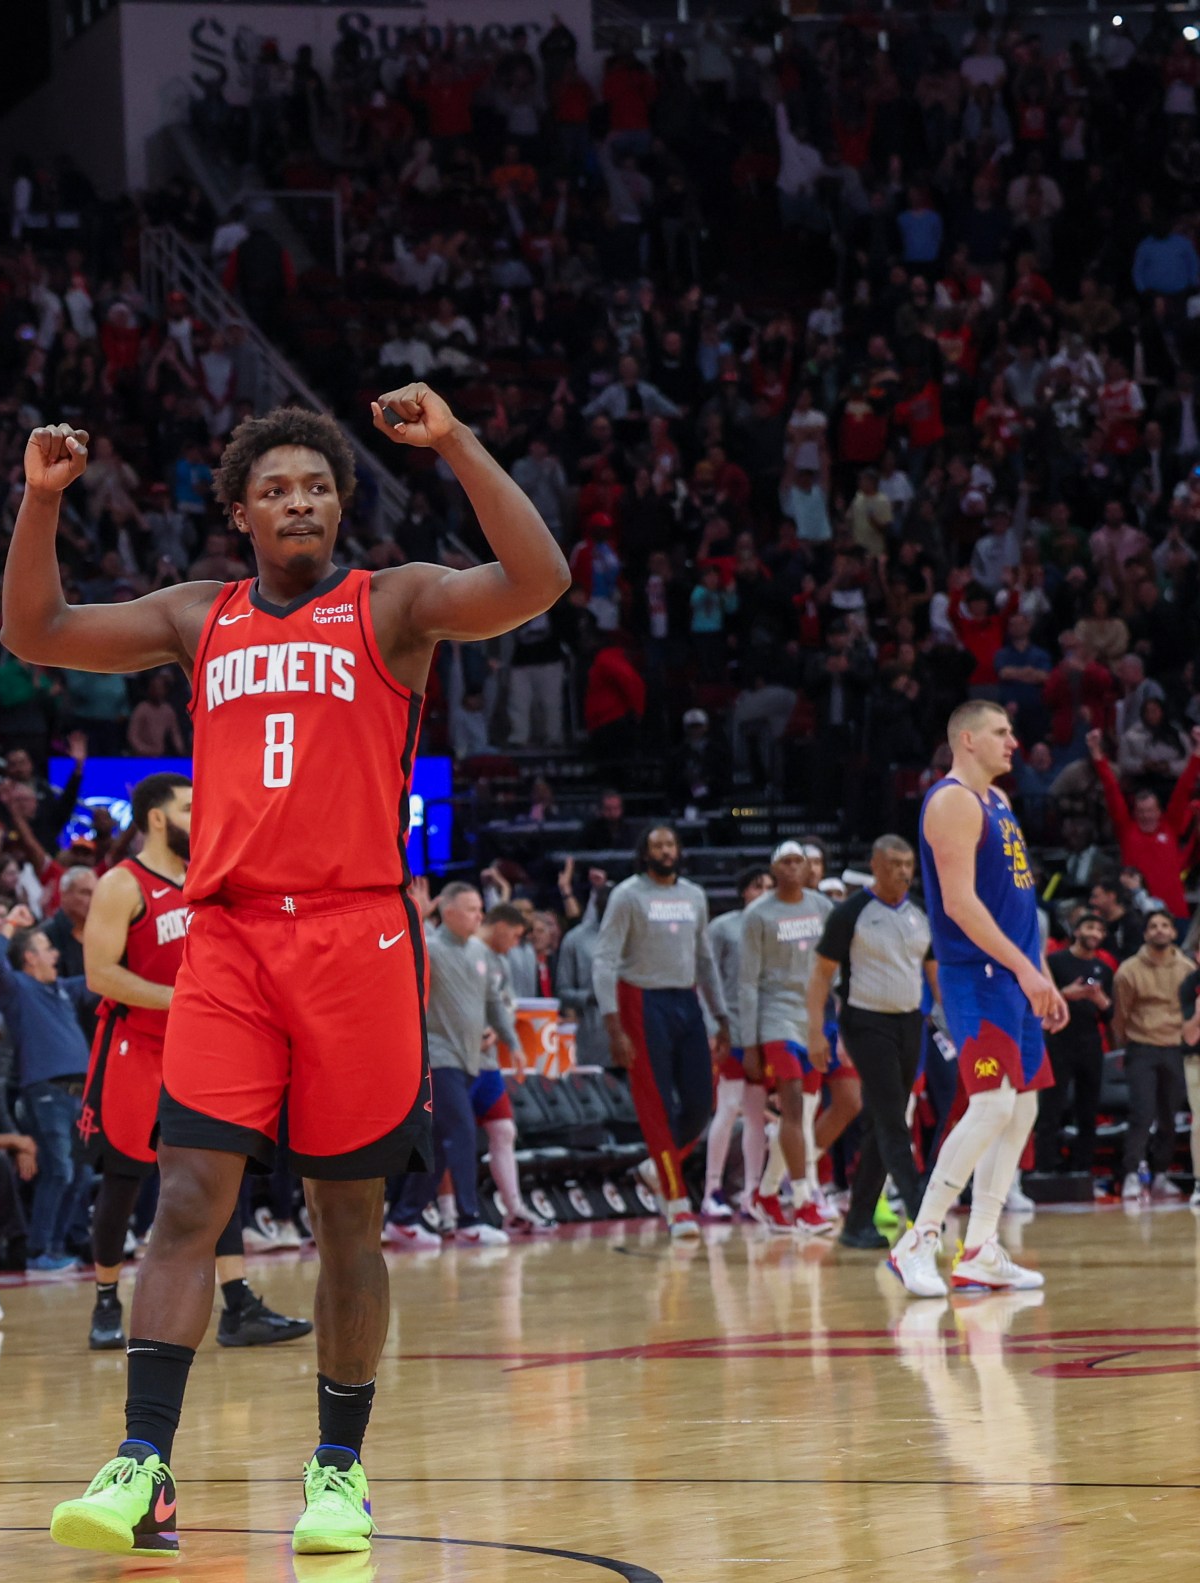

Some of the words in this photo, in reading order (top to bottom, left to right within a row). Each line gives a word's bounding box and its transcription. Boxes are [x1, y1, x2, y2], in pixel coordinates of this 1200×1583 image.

[312, 611, 354, 624] karma
[206, 641, 355, 713] ROCKETS
[263, 712, 295, 789] 8
[155, 907, 190, 946] ROC
